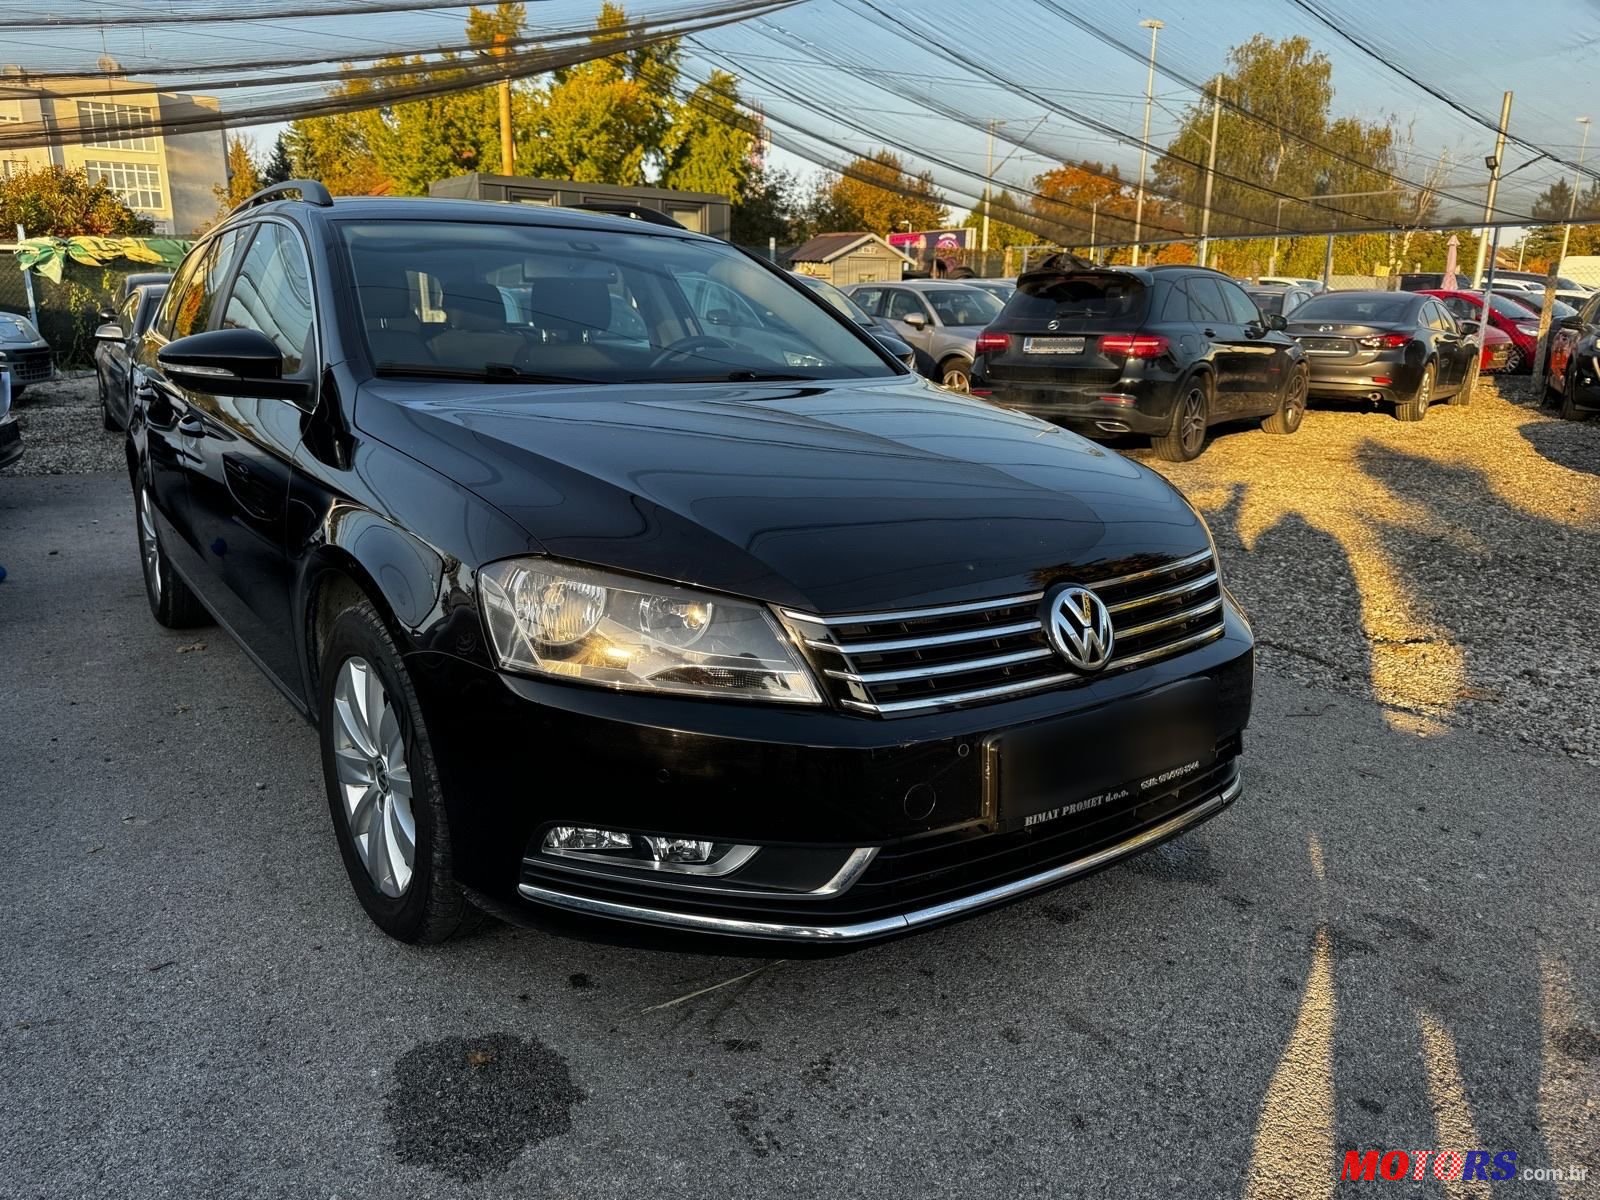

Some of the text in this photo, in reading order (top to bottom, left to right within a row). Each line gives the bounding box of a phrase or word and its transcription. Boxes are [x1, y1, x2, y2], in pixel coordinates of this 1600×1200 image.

[1054, 589, 1112, 667] VW
[1024, 789, 1129, 827] BIMAT PROMET d.o.o.
